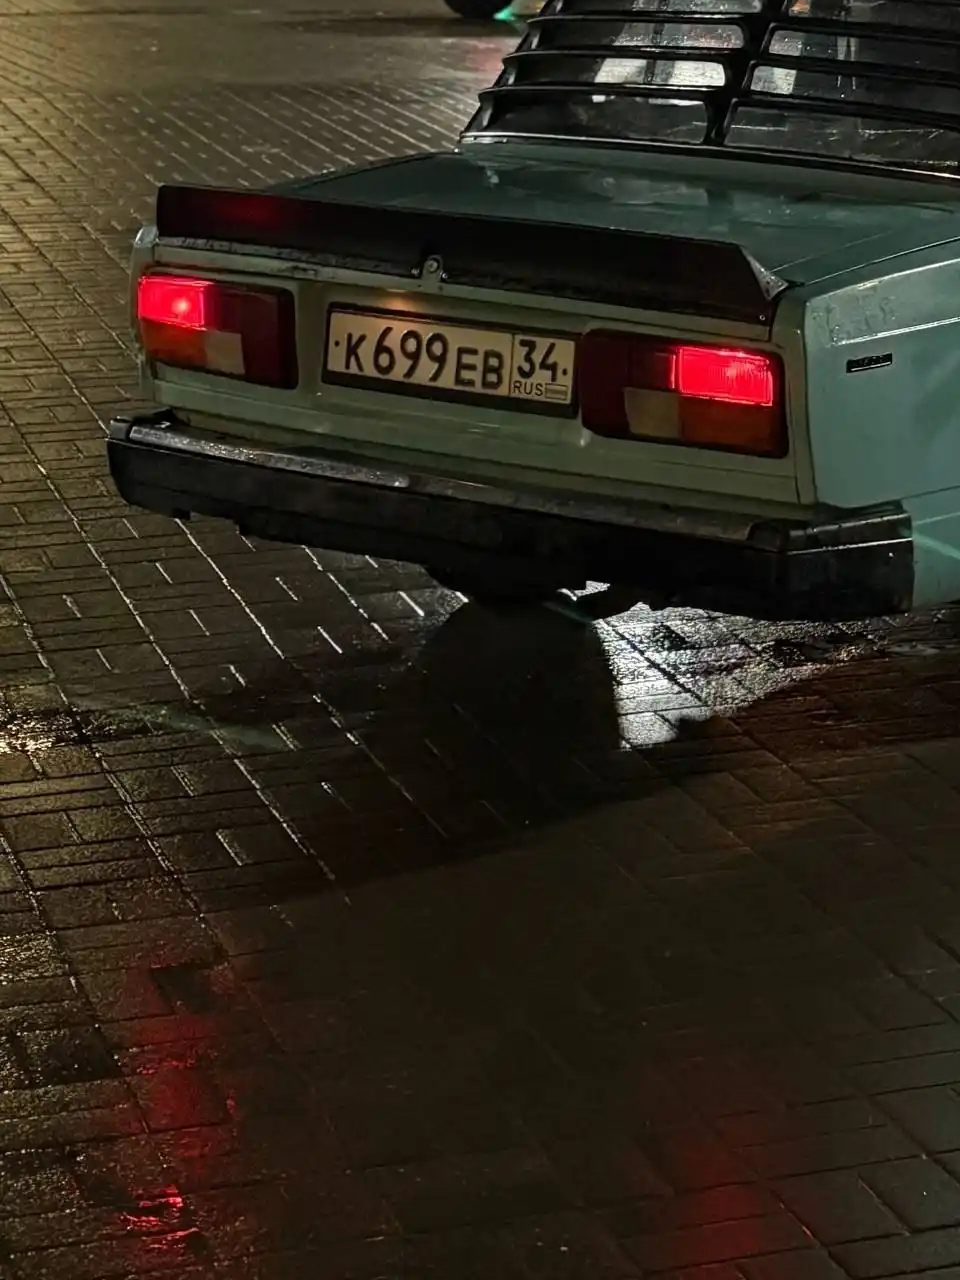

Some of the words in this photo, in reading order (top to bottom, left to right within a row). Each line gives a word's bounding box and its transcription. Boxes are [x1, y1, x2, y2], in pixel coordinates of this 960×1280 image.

[344, 326, 505, 390] К699ЕВ
[516, 339, 558, 382] 34
[512, 380, 544, 398] RUS
